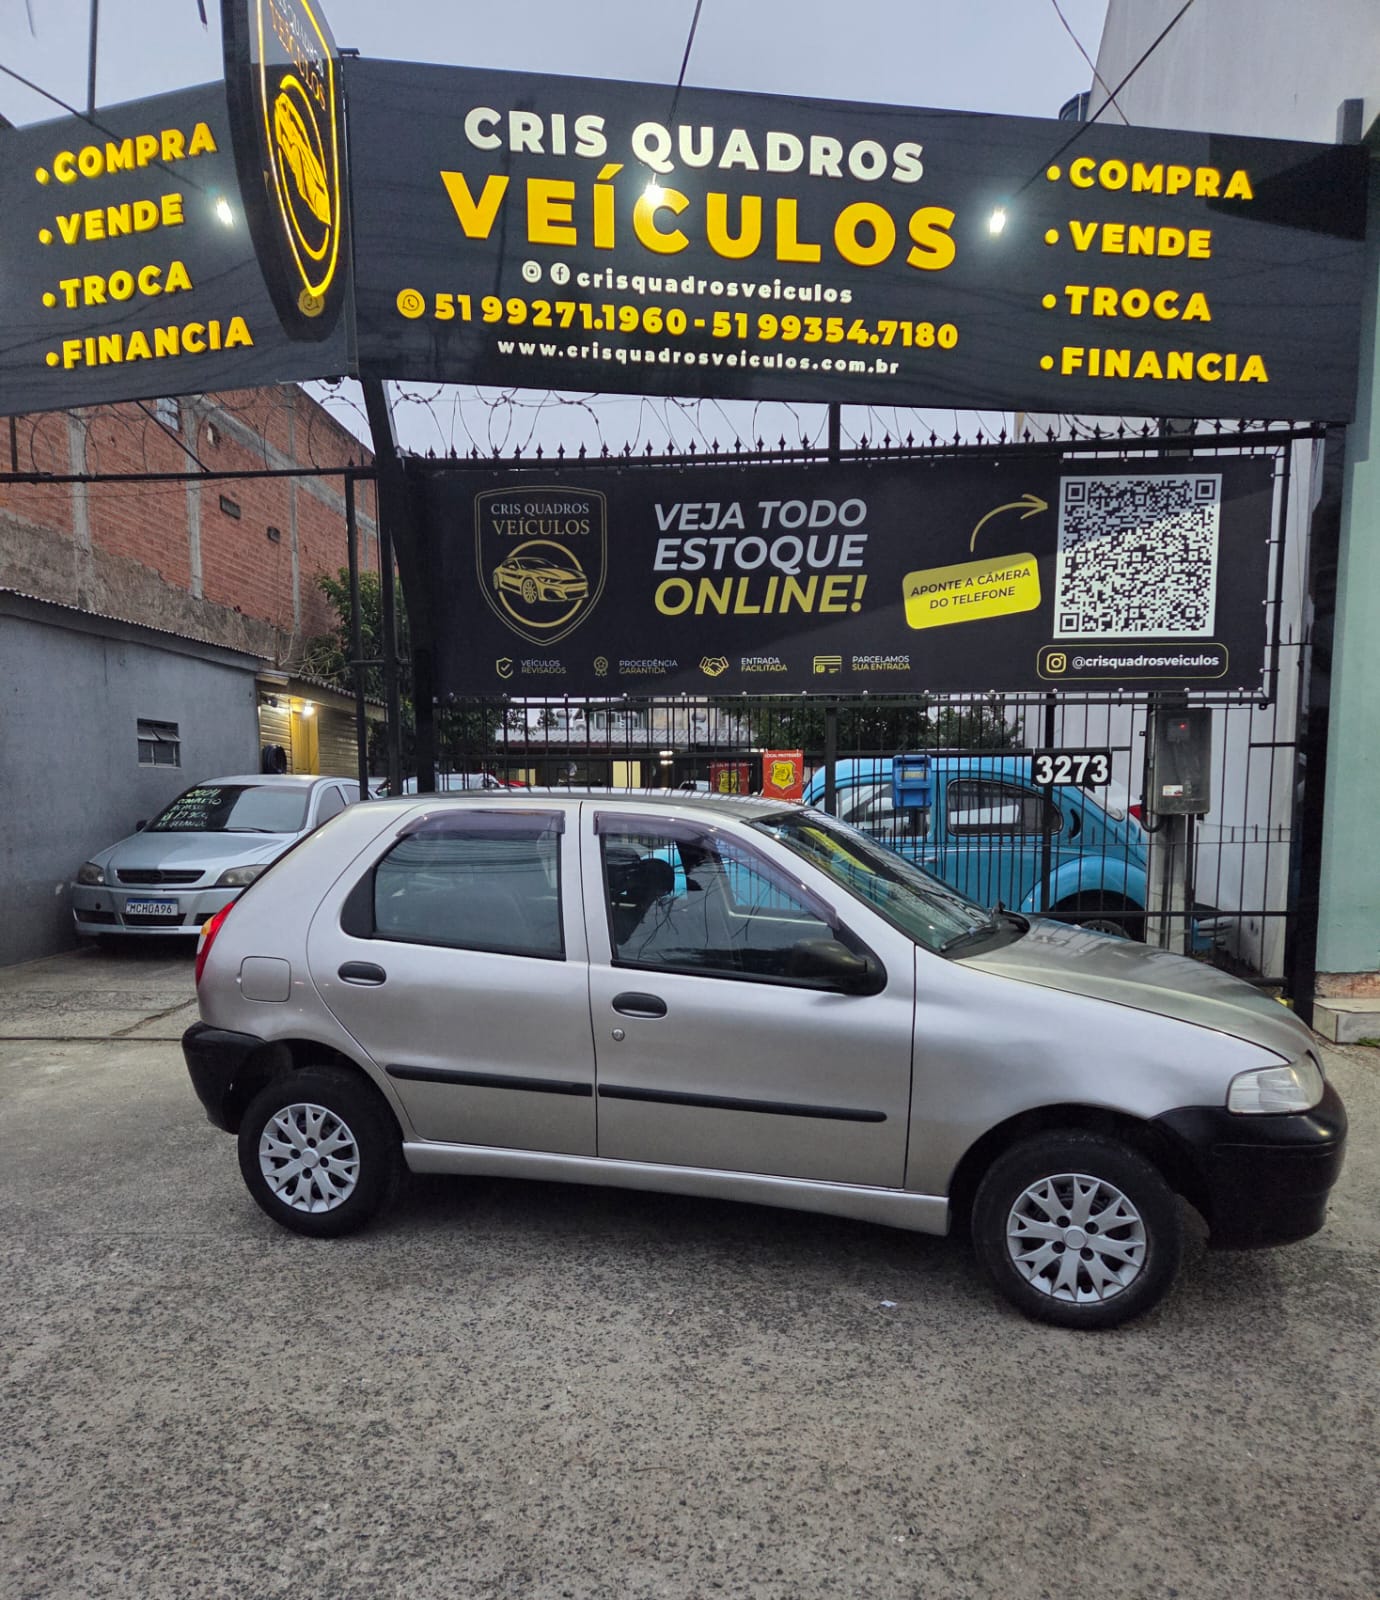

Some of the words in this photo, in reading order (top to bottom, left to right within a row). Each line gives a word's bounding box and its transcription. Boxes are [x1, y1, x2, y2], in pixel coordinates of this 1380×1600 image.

[53, 121, 217, 183] COMPRA
[464, 106, 607, 158] CRIS
[631, 121, 924, 183] QUADROS
[1068, 157, 1253, 201] COMPRA
[56, 193, 184, 245] VENDE
[440, 163, 956, 271] VEÍCULOS
[1068, 220, 1212, 260] VENDE
[59, 261, 193, 308] TROCA
[577, 268, 852, 304] crisquadrosveiculos
[434, 293, 472, 321] 51
[481, 295, 687, 336] 99271.1960
[712, 311, 748, 339] 51
[757, 313, 959, 349] 99354.7180
[1064, 285, 1212, 322] TROCA
[62, 316, 254, 370] FINANCIA
[498, 340, 899, 375] www.crisquadrosveiculos.com.br
[1061, 347, 1269, 384] FINANCIA
[491, 503, 520, 514] CRIS
[524, 503, 589, 516] QUADROS
[492, 517, 590, 535] VEÍCULOS
[654, 502, 745, 531] VEJA
[758, 499, 867, 529] TODO
[653, 534, 868, 575] ESTOQUE
[654, 574, 867, 616] ONLINE!
[911, 579, 963, 597] APONTE
[965, 578, 974, 587] A
[977, 568, 1031, 585] CÂMERA
[930, 598, 949, 609] DO
[952, 586, 1016, 605] TELEFONE
[741, 657, 780, 665] ENTRADA
[741, 664, 788, 672] FACILITADA
[852, 663, 868, 671] SUA
[871, 662, 911, 670] ENTRADA
[1072, 654, 1219, 670] @crisquadrosveiculos
[1035, 754, 1108, 783] 3273
